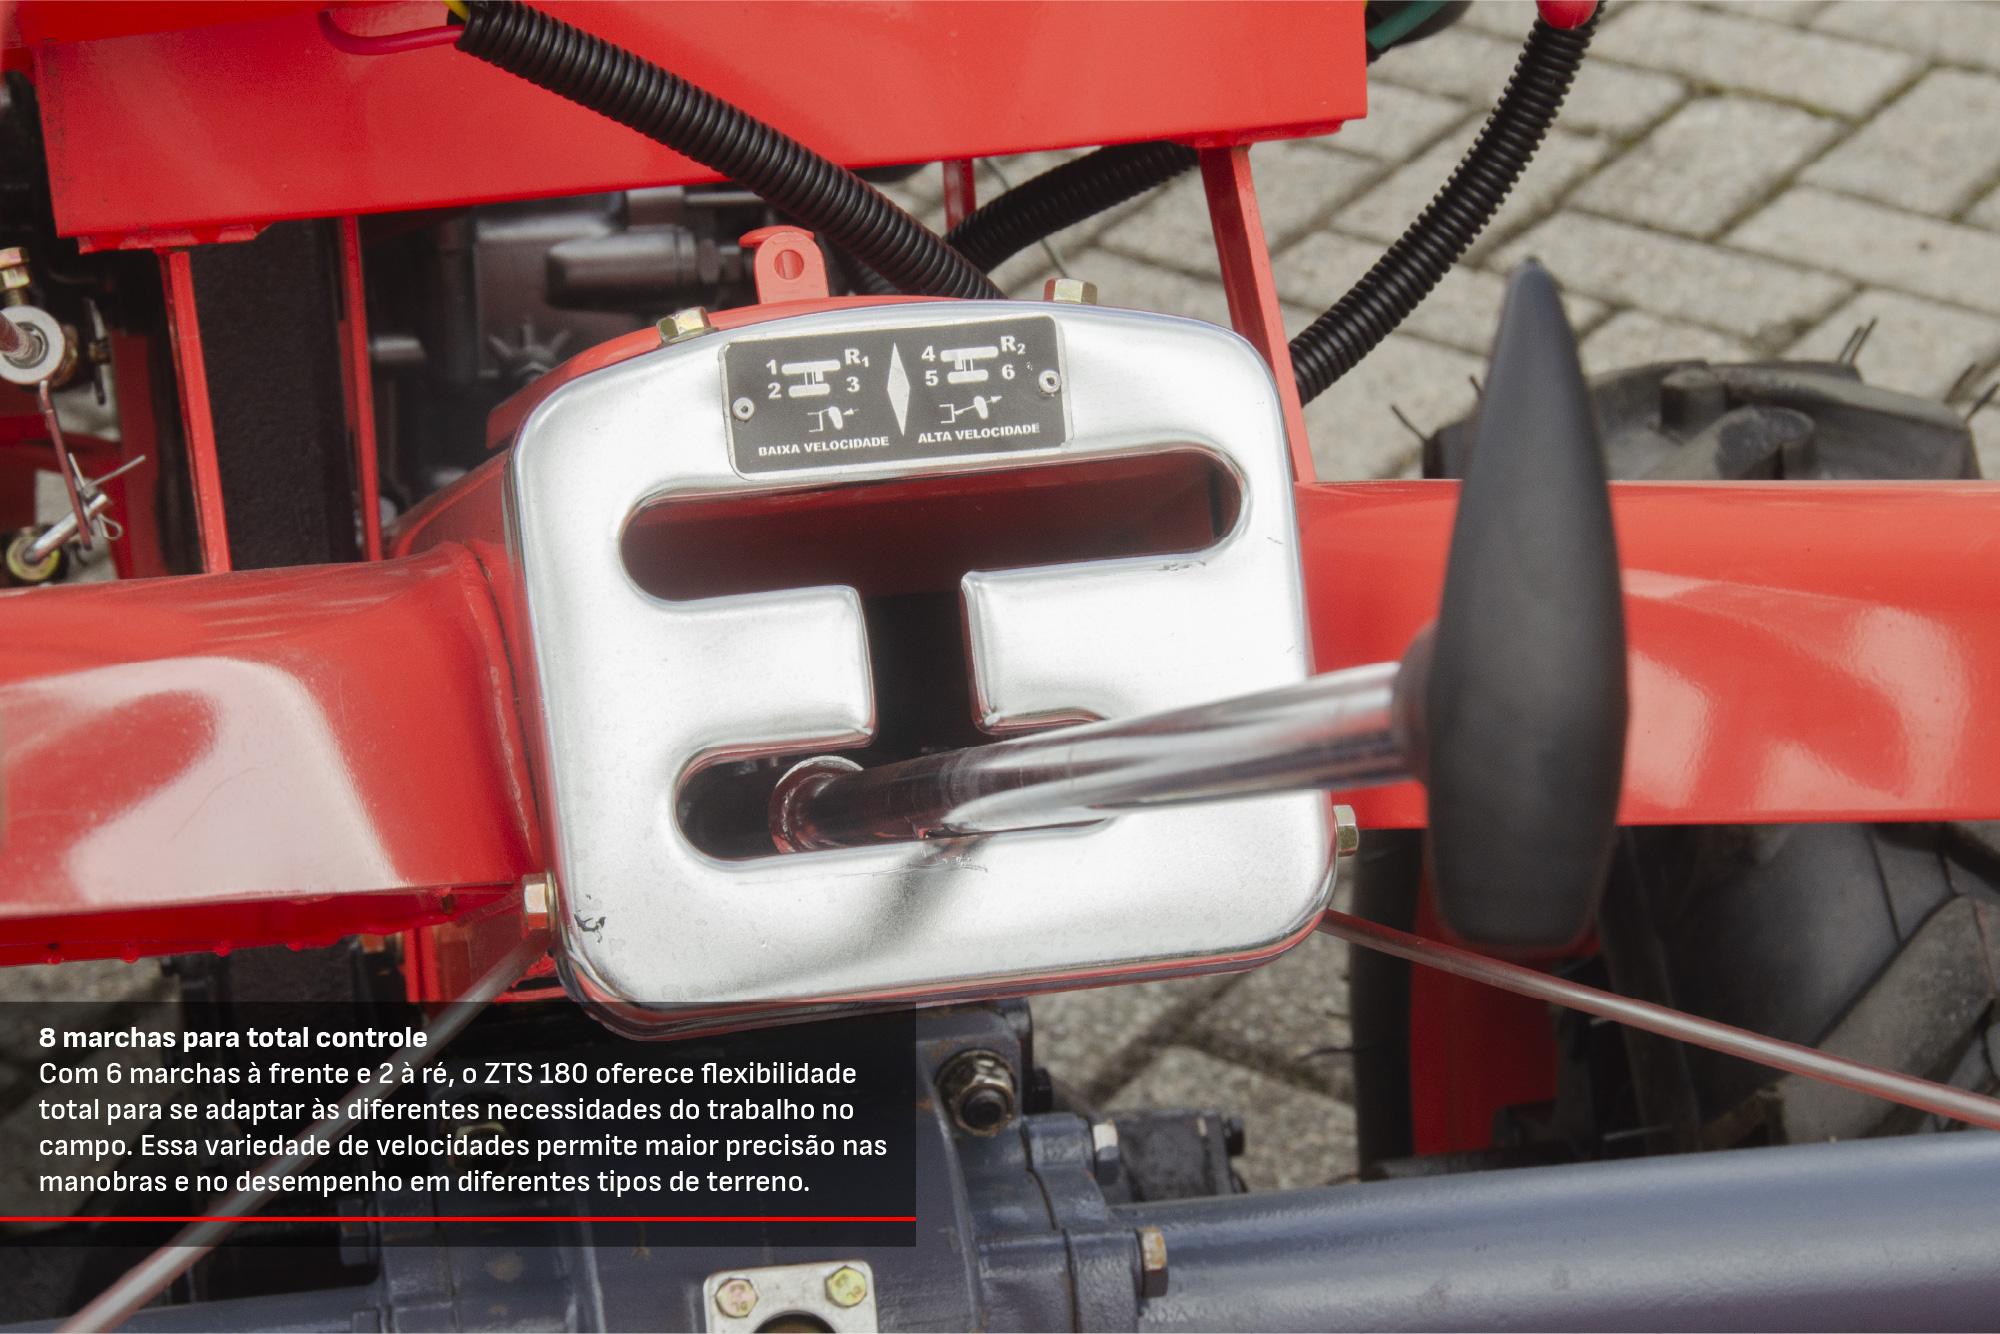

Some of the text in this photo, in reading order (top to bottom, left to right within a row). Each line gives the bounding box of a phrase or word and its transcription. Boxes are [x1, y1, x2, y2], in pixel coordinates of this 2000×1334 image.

[922, 346, 935, 362] 4
[766, 359, 777, 375] 1
[925, 364, 1015, 386] 5 6
[768, 376, 860, 398] 2 3
[918, 423, 1040, 443] ALTA VELOCIDADE
[758, 436, 889, 456] BAIXA VELOCIDADE
